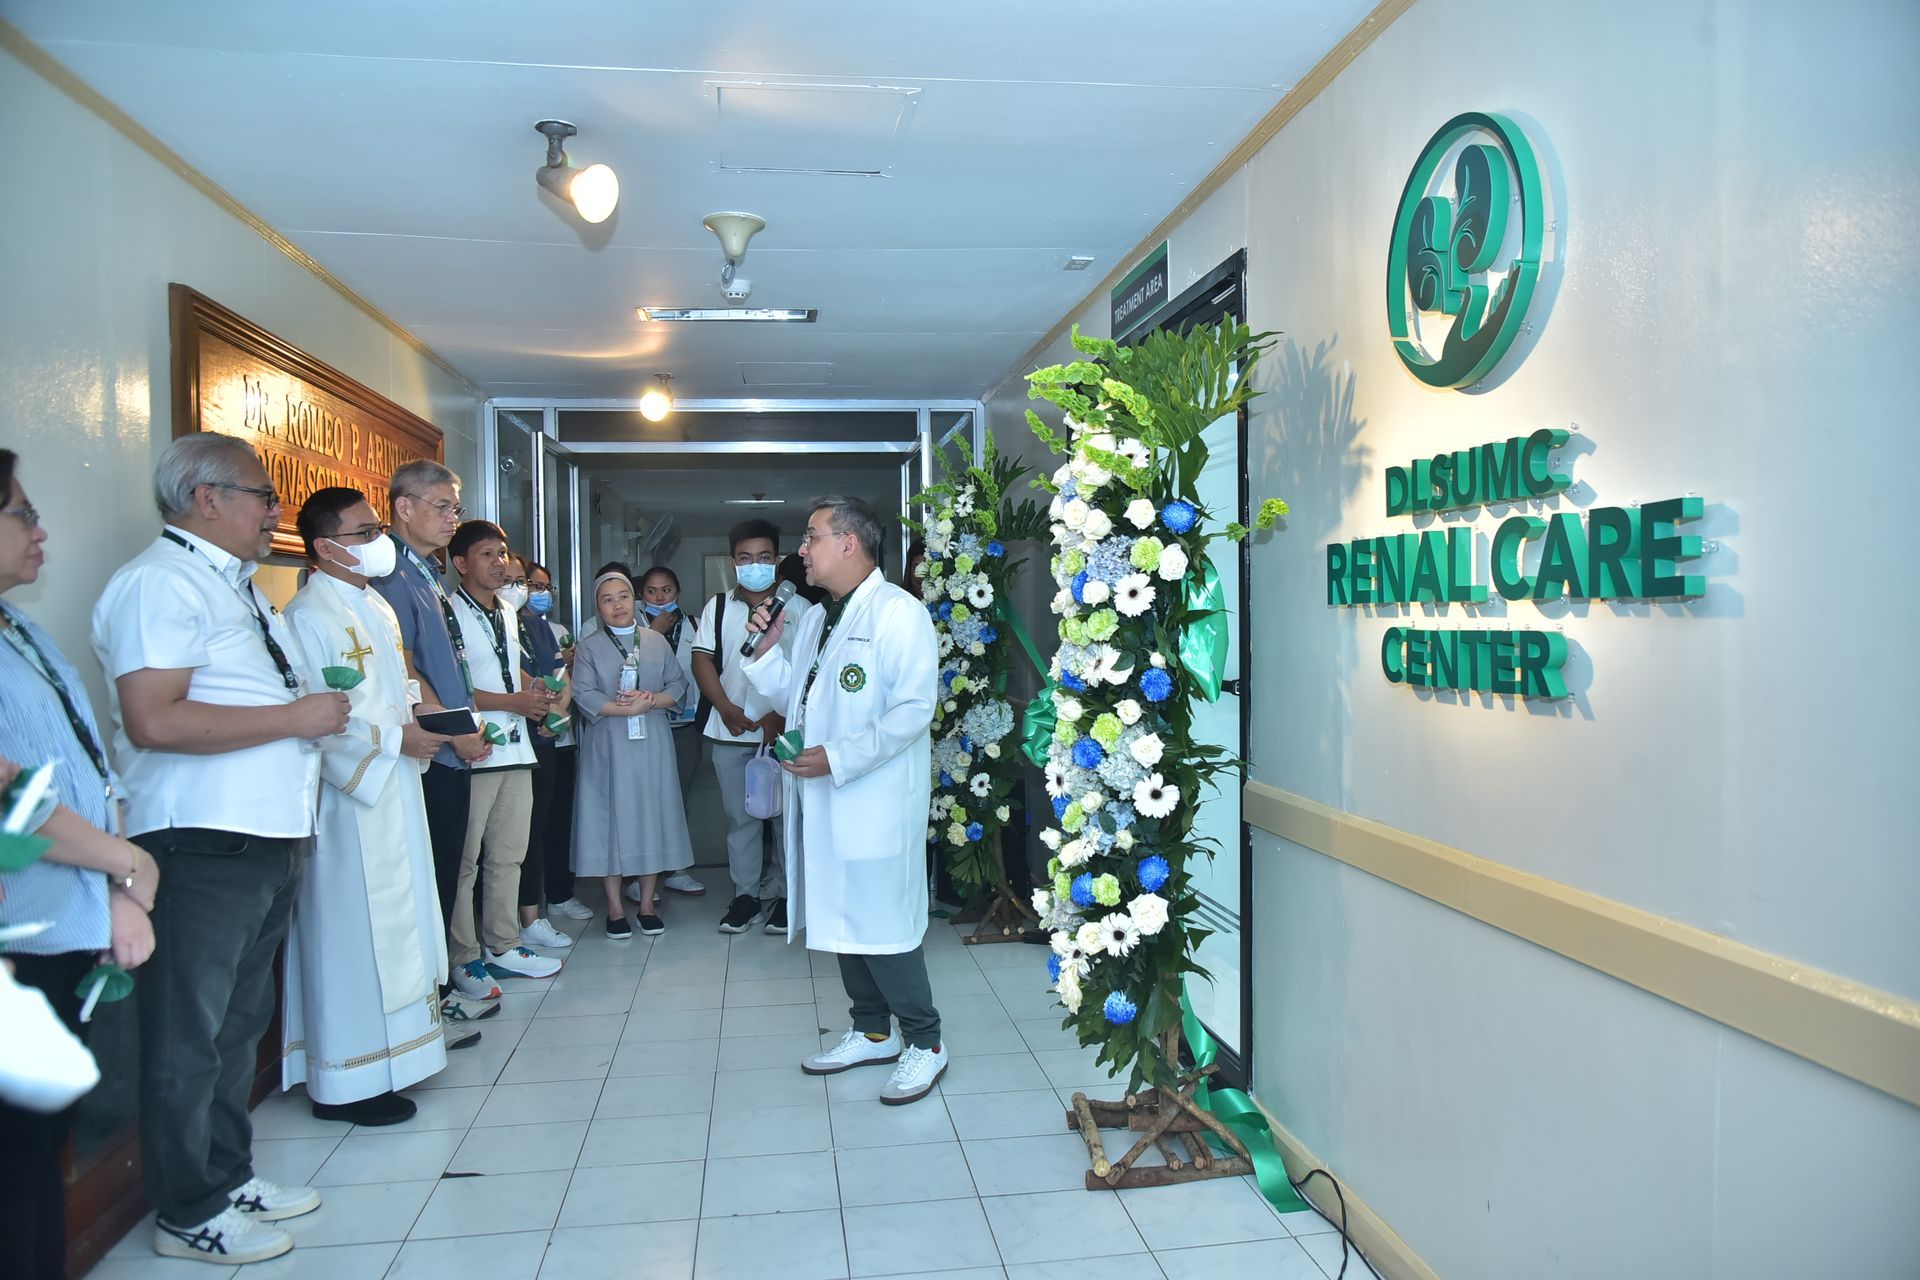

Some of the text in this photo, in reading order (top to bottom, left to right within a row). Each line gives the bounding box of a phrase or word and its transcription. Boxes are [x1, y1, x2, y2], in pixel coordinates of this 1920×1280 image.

[1114, 273, 1163, 325] TREATMENT AREA
[243, 374, 276, 438] DR.
[286, 393, 344, 461] ROMEO
[350, 423, 361, 468] P.
[1385, 429, 1570, 517] DLSUMC
[1327, 497, 1705, 605] RENAL CARE
[1382, 626, 1568, 699] CENTER
